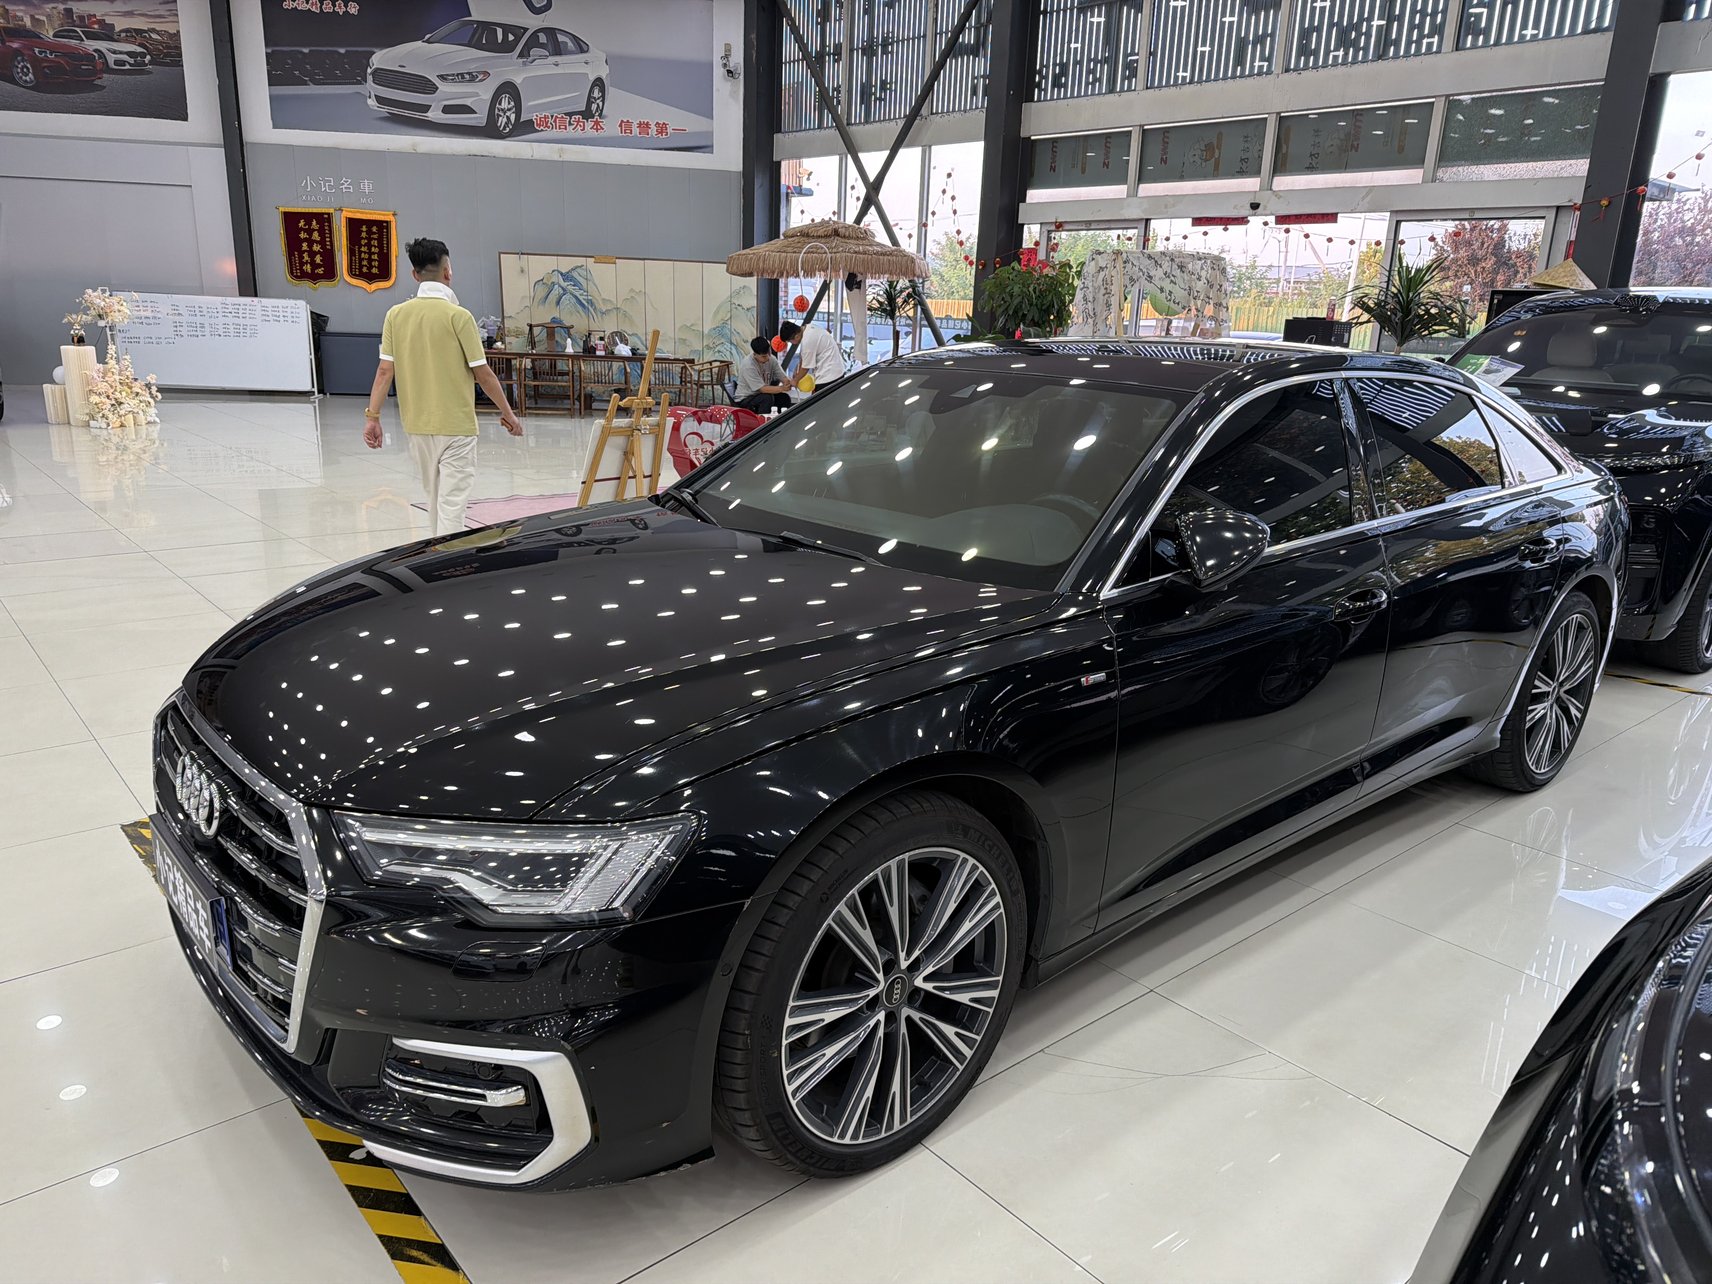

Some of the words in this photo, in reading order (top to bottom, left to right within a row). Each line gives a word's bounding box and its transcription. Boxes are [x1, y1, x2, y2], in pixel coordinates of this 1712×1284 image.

[533, 112, 606, 134] 诚信为本
[617, 119, 689, 138] 信誉第一
[155, 839, 212, 954] 小记精品车
